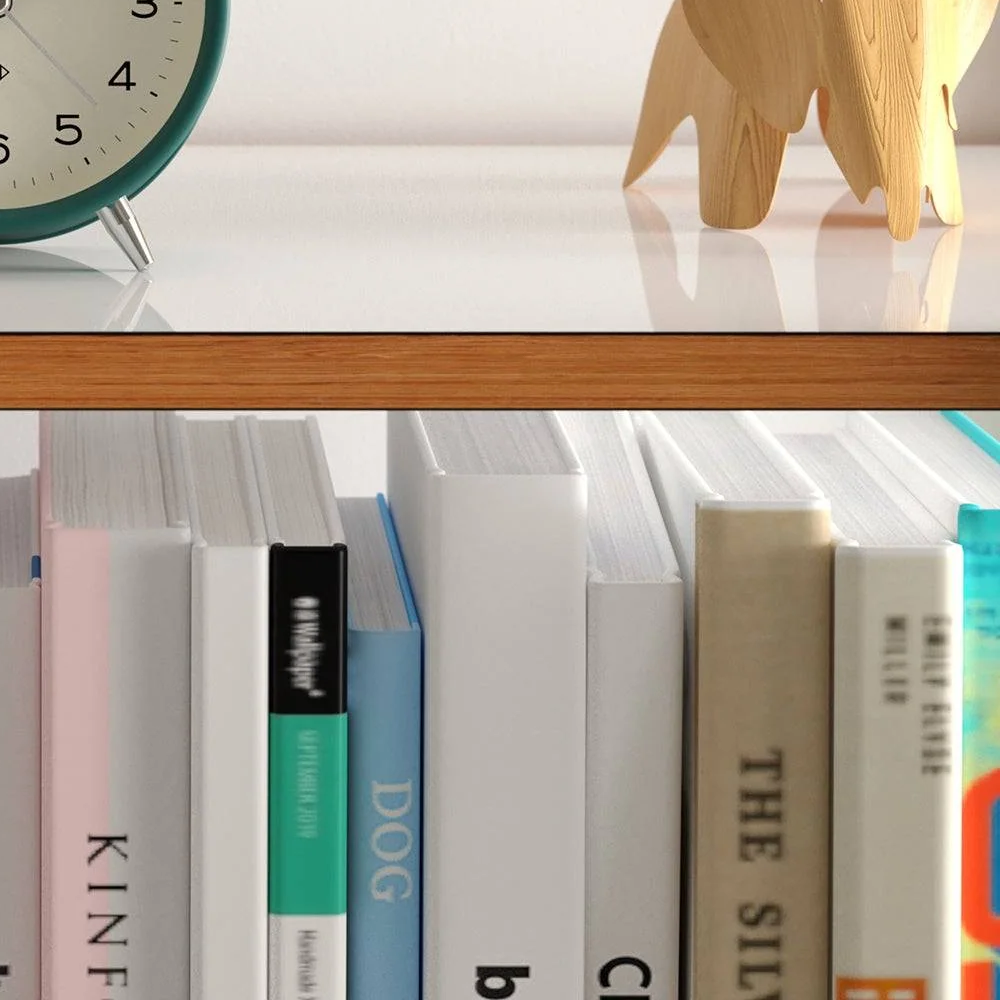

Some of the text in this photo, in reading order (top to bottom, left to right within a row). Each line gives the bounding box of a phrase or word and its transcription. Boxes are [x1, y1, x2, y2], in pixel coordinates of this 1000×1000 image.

[107, 60, 137, 92] 4
[54, 114, 83, 146] 5
[370, 779, 413, 903] DOG
[738, 748, 784, 1000] THE SIL
[597, 956, 653, 1000] C
